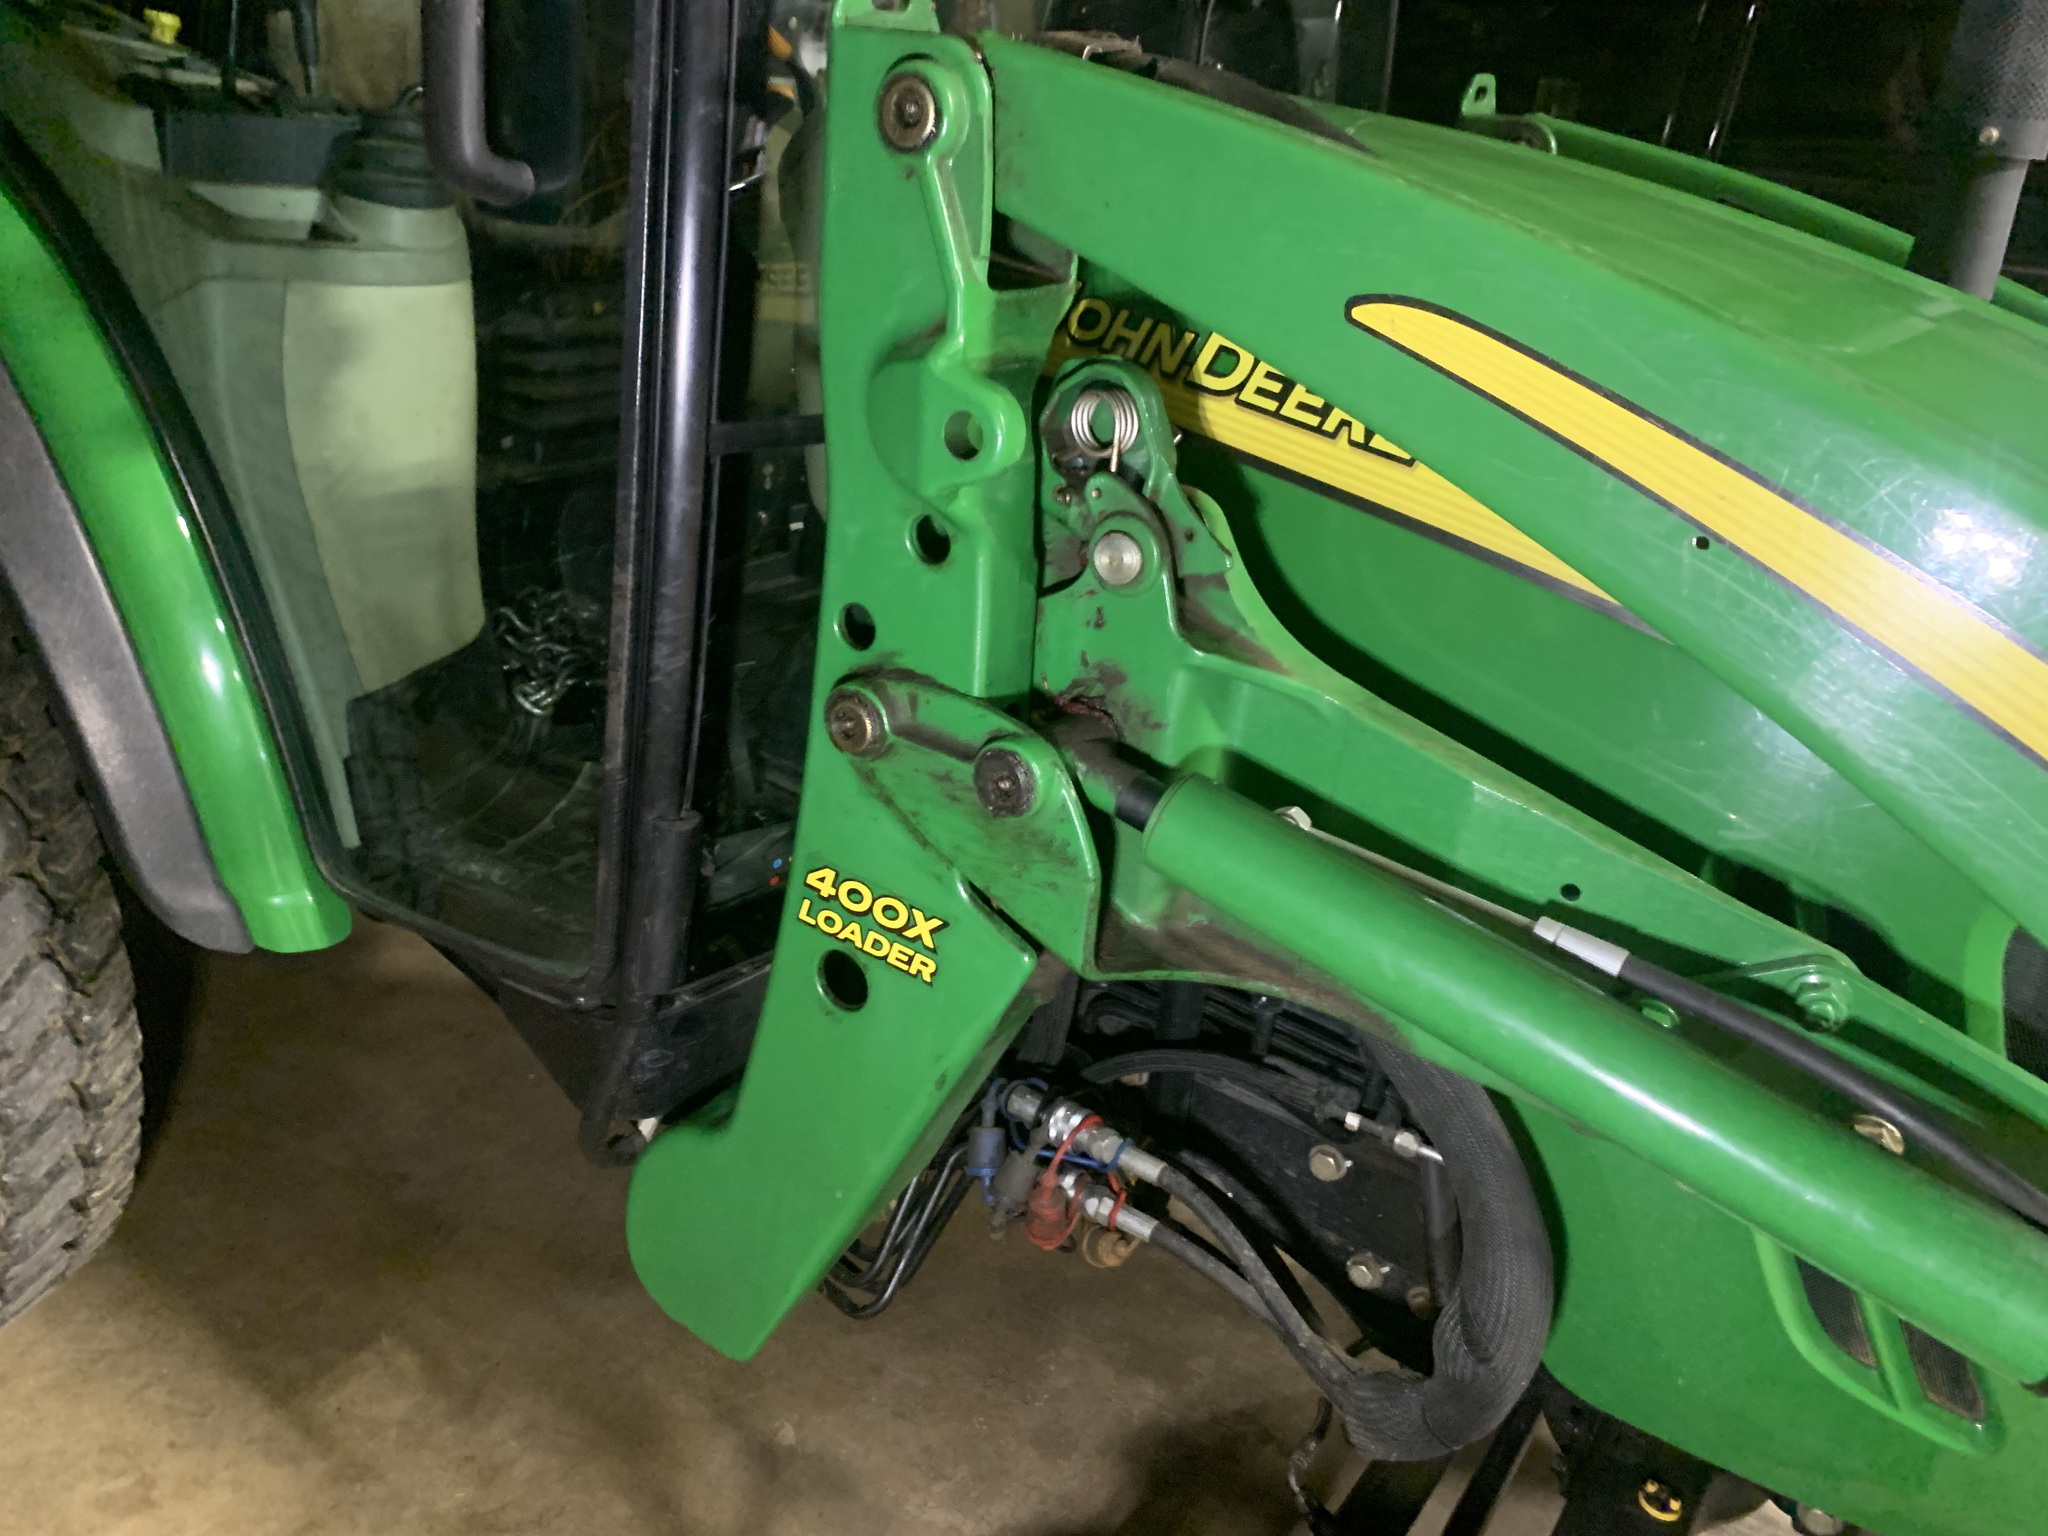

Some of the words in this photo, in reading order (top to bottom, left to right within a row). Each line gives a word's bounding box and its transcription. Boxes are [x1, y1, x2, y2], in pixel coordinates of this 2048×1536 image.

[1066, 281, 1199, 378] OHN
[798, 898, 937, 984] LOADER
[805, 867, 947, 950] 400X
